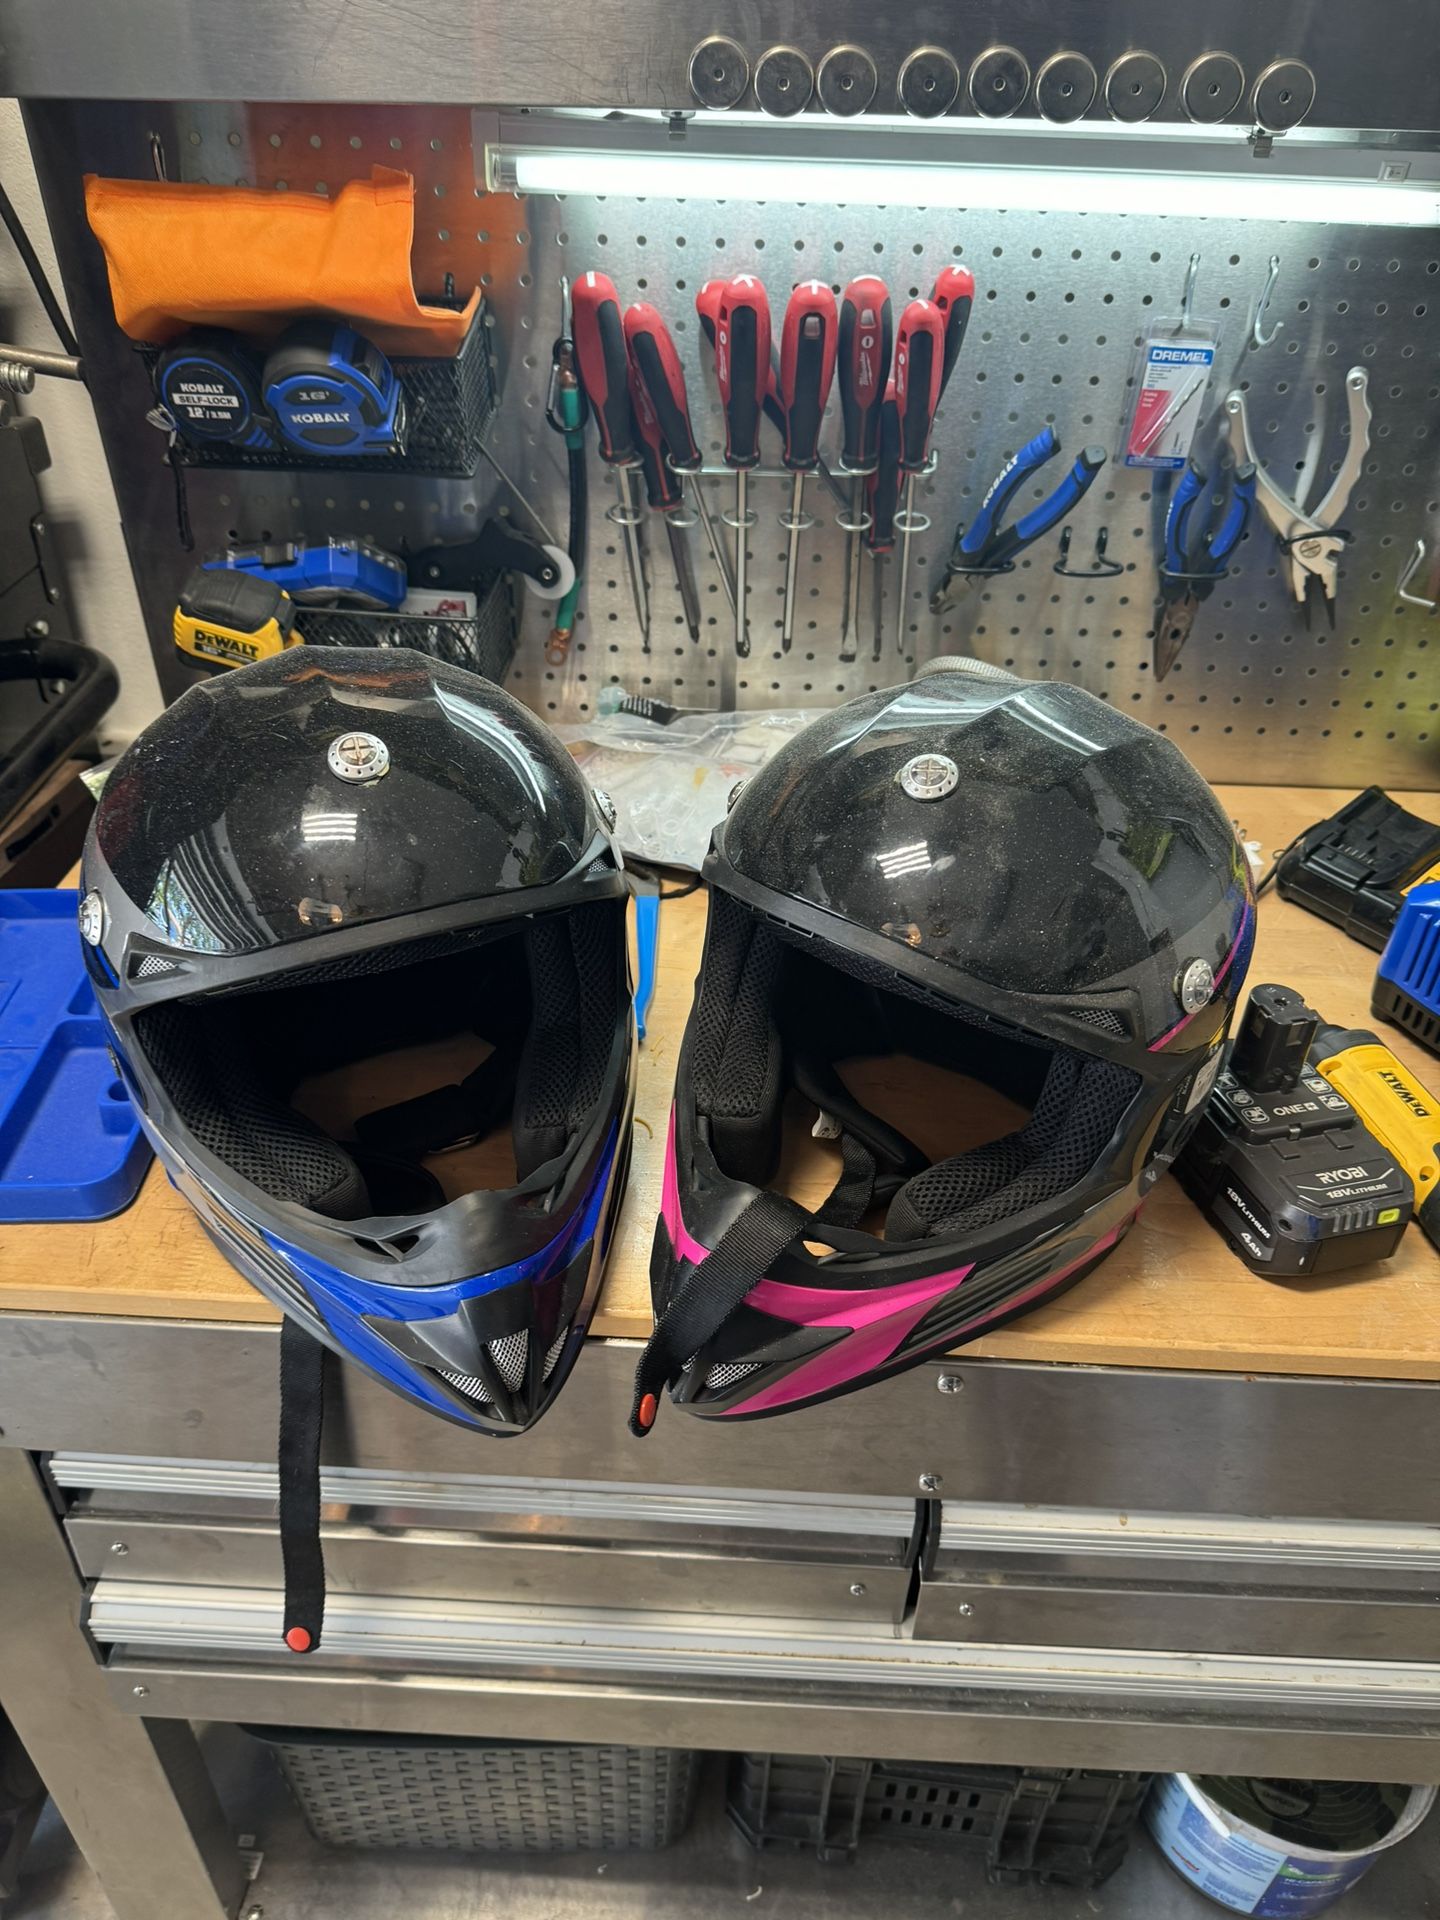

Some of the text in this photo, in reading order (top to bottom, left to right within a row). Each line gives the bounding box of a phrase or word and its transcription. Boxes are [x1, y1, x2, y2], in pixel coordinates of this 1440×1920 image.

[1151, 349, 1209, 362] DREMEL
[179, 383, 225, 394] KOBALT
[178, 395, 234, 405] SELF-LOCK
[290, 412, 351, 424] KOBALT
[982, 453, 1019, 509] KOBALT
[194, 629, 259, 657] DEWALT
[1376, 1071, 1432, 1117] DEWALT
[1315, 1165, 1369, 1184] RYOBI
[1241, 1232, 1262, 1257] 4Ah
